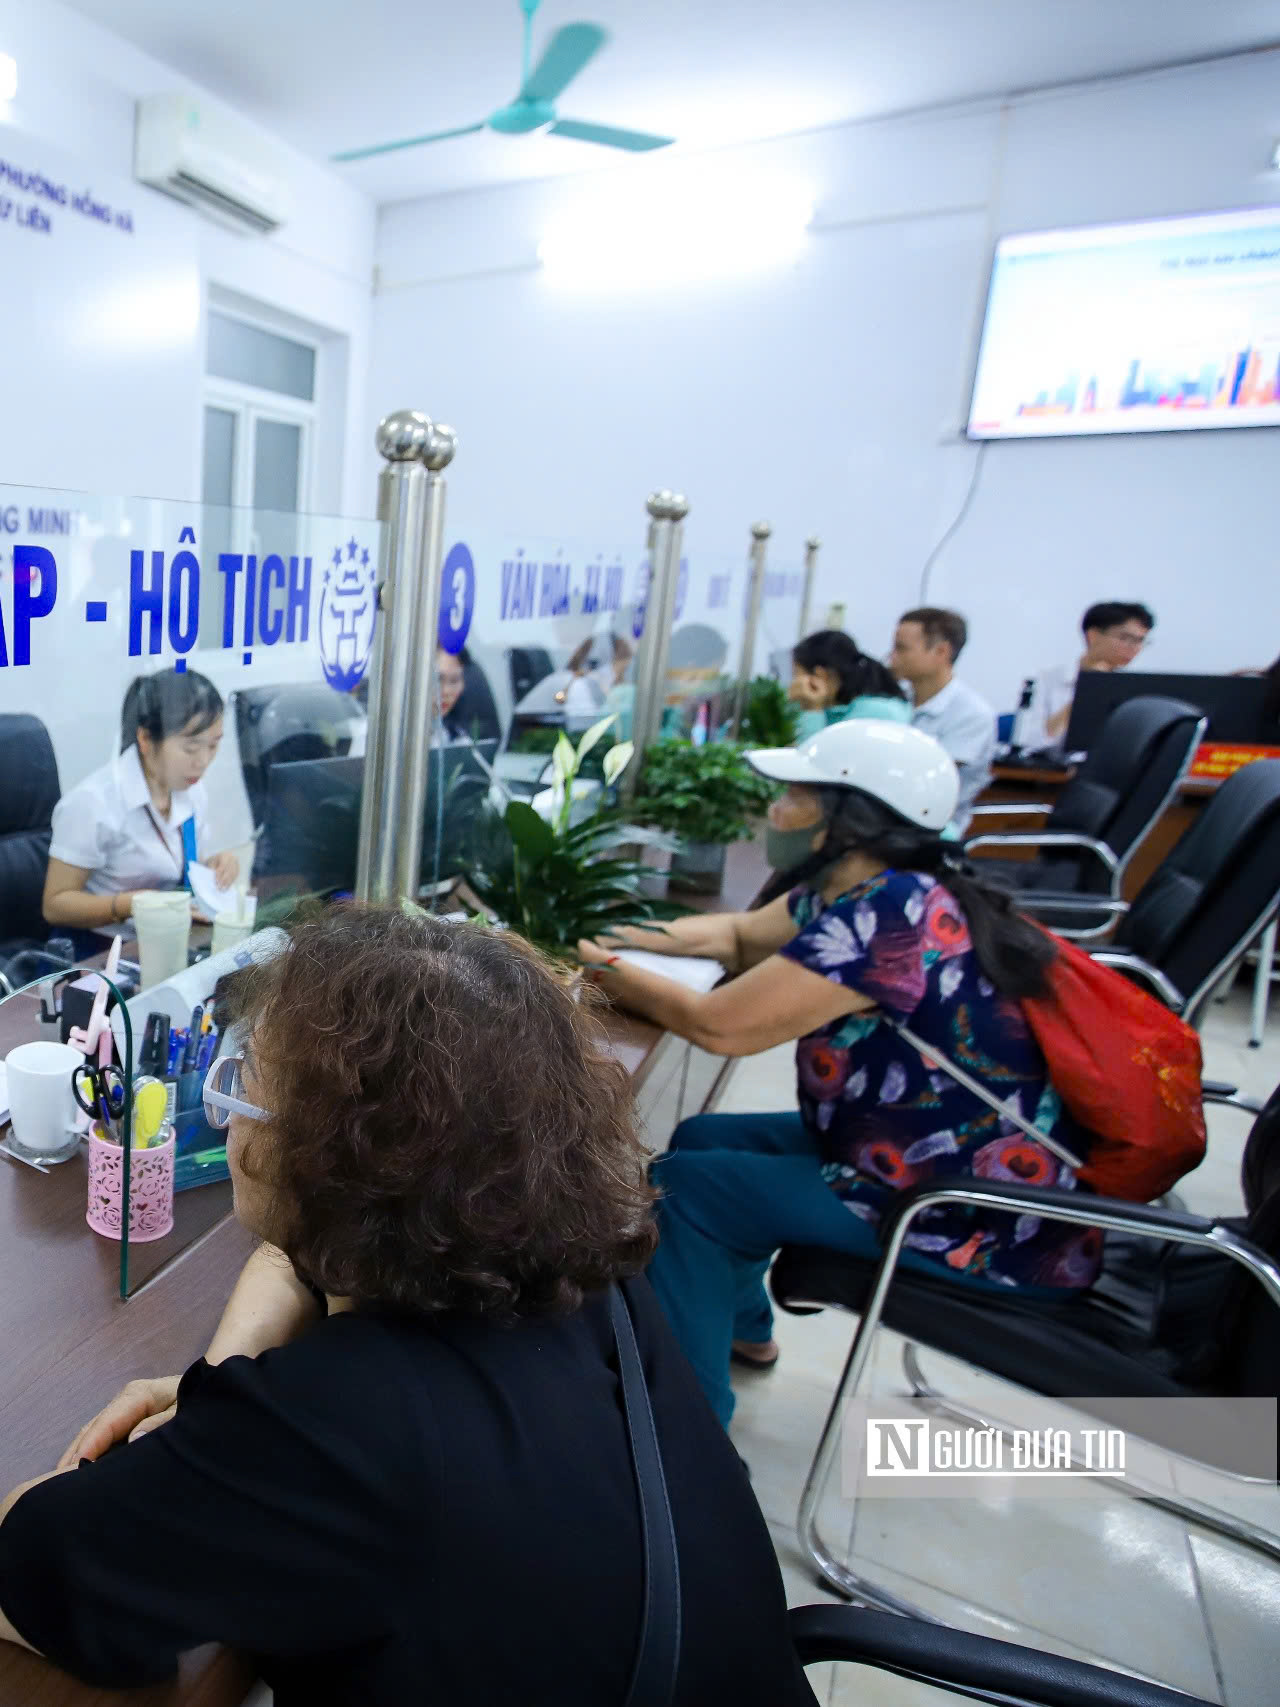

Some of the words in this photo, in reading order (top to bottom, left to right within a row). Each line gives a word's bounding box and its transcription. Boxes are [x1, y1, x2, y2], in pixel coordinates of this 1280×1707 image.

[86, 601, 108, 622] -
[128, 526, 200, 674] HỘ
[218, 553, 312, 666] TỊCH
[450, 567, 467, 631] 3
